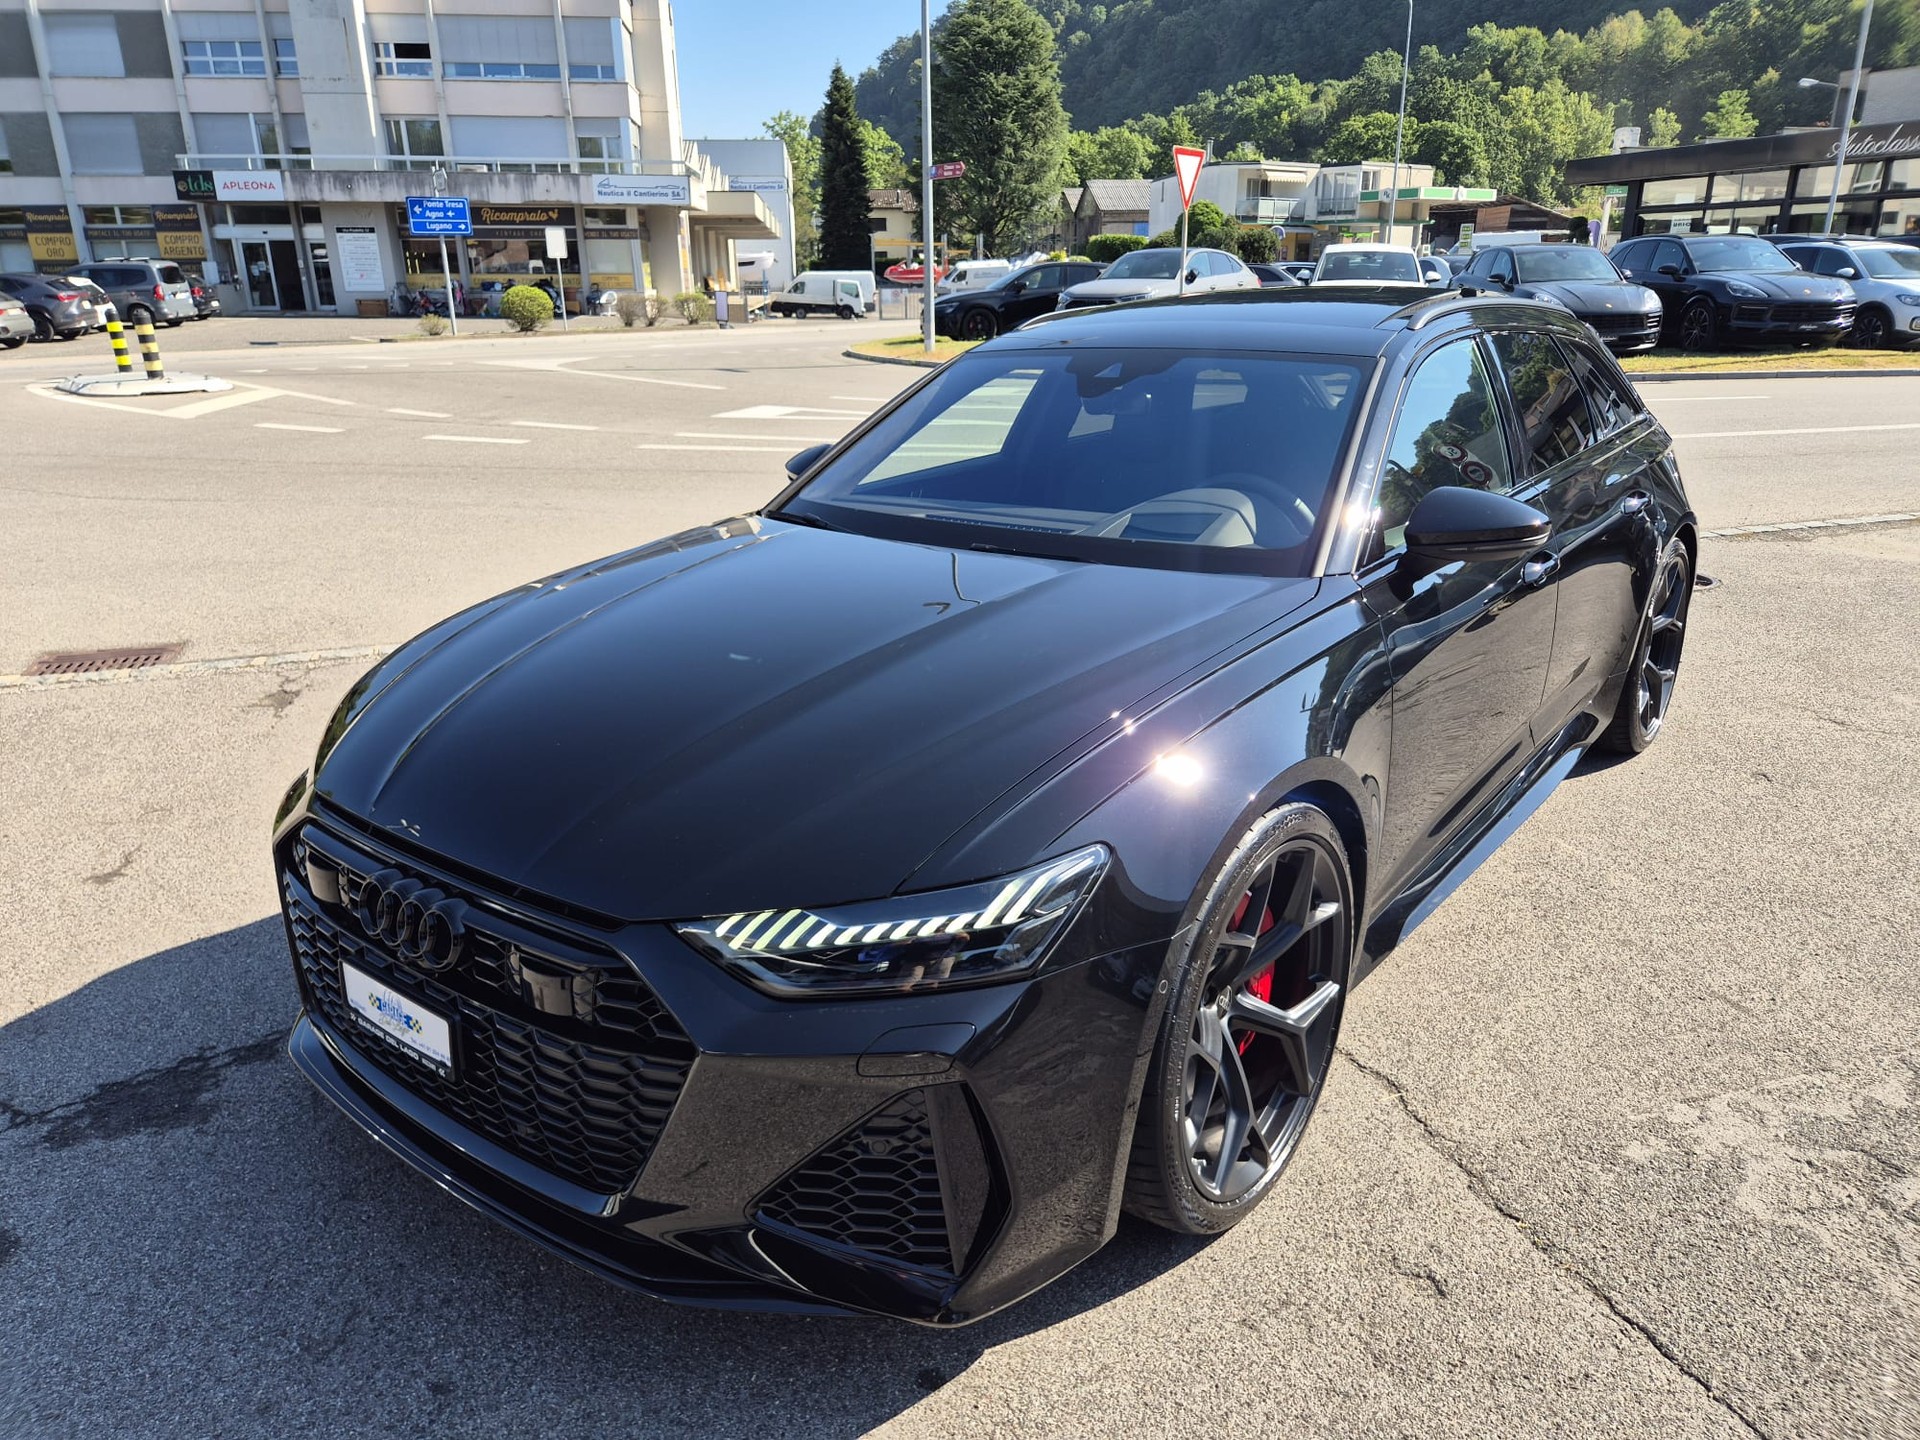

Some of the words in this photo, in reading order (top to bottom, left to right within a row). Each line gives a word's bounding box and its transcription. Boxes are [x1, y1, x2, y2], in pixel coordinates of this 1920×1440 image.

[222, 181, 276, 190] APLEONA
[633, 190, 669, 198] Cantierino
[423, 200, 444, 208] Ponte
[26, 212, 69, 223] Ricompralo
[425, 210, 444, 219] Agno
[481, 208, 549, 224] Ricompralo
[426, 222, 453, 231] Lugano
[35, 236, 71, 246] COMPRO
[163, 235, 200, 245] COMPRO
[46, 247, 65, 258] ORO
[163, 246, 205, 256] ARGENTO
